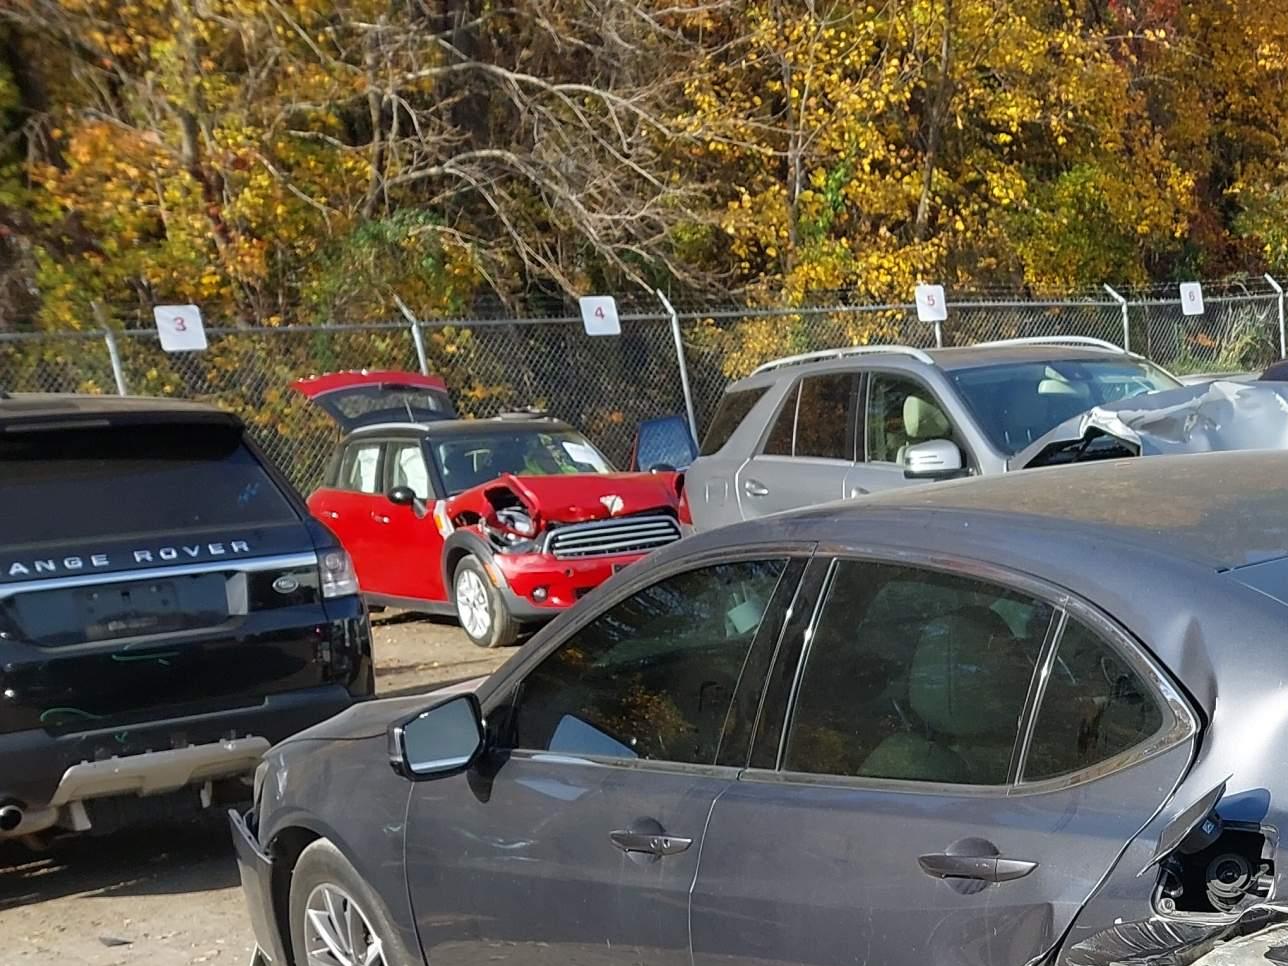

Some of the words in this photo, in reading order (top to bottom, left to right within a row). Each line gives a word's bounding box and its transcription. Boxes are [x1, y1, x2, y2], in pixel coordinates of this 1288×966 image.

[927, 295, 936, 306] 5
[1189, 291, 1196, 301] 6
[595, 306, 605, 319] 4
[174, 316, 187, 331] 3
[0, 554, 110, 576] ANGE
[134, 540, 250, 562] ROVER
